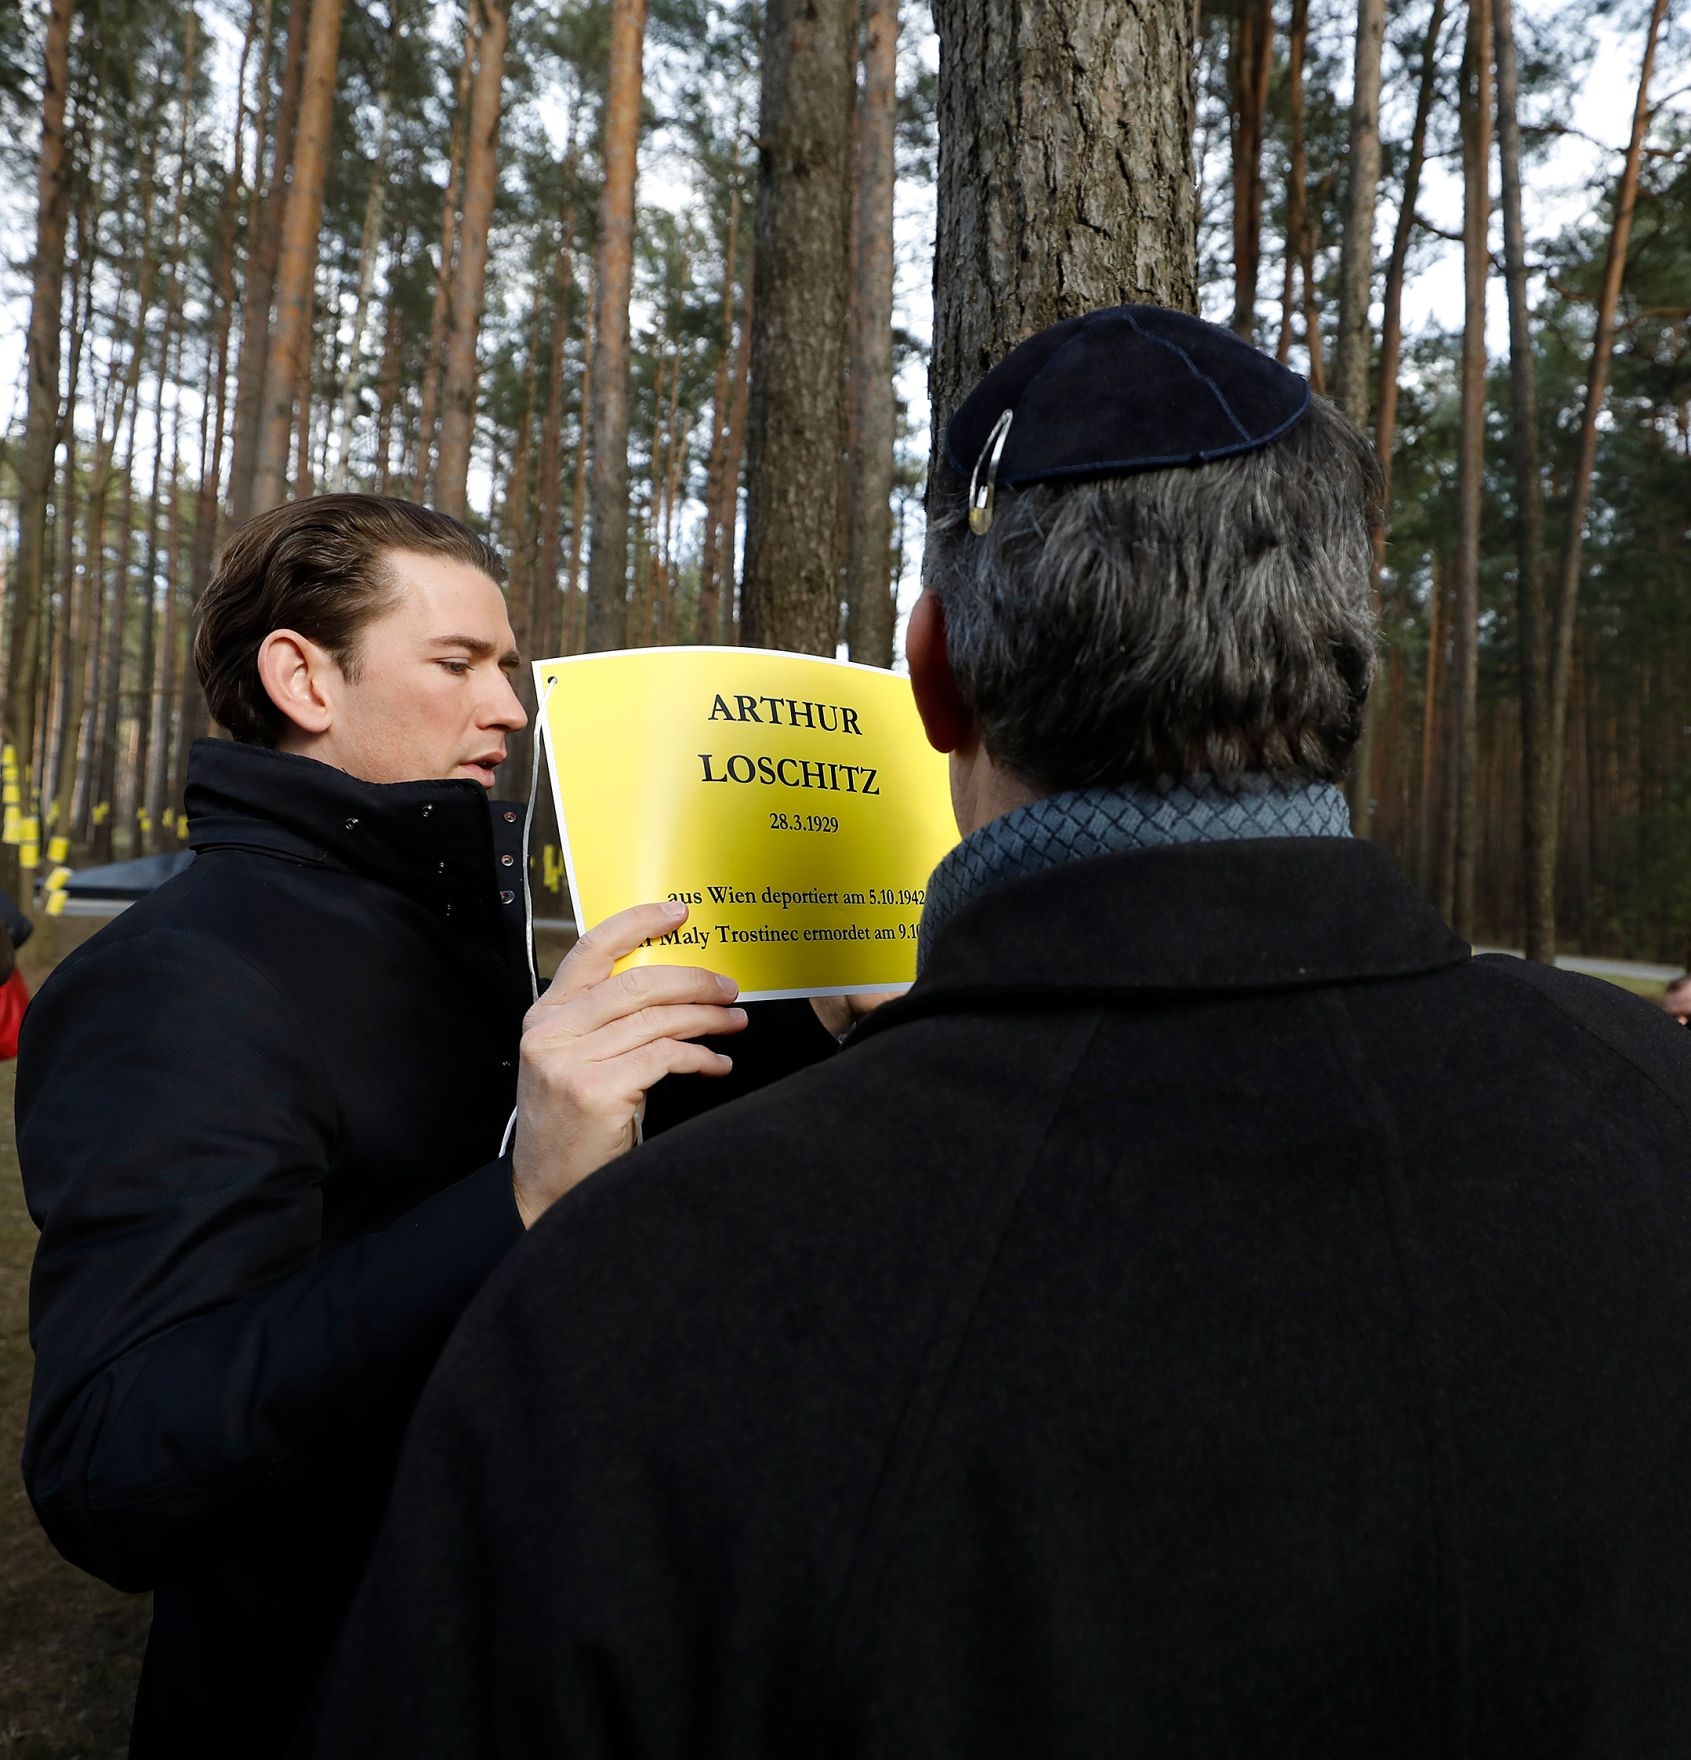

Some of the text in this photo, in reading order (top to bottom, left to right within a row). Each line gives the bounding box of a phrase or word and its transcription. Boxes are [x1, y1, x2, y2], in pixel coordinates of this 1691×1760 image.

[707, 693, 863, 736] ARTHUR
[697, 754, 880, 796] LOSCHITZ
[769, 812, 839, 833] 28.3.1929
[667, 886, 925, 910] aus Wien deportiert am 5.10.1942
[659, 926, 711, 950] Maly
[714, 924, 799, 943] Trostinec
[803, 923, 871, 942] ermordet
[874, 928, 896, 940] am
